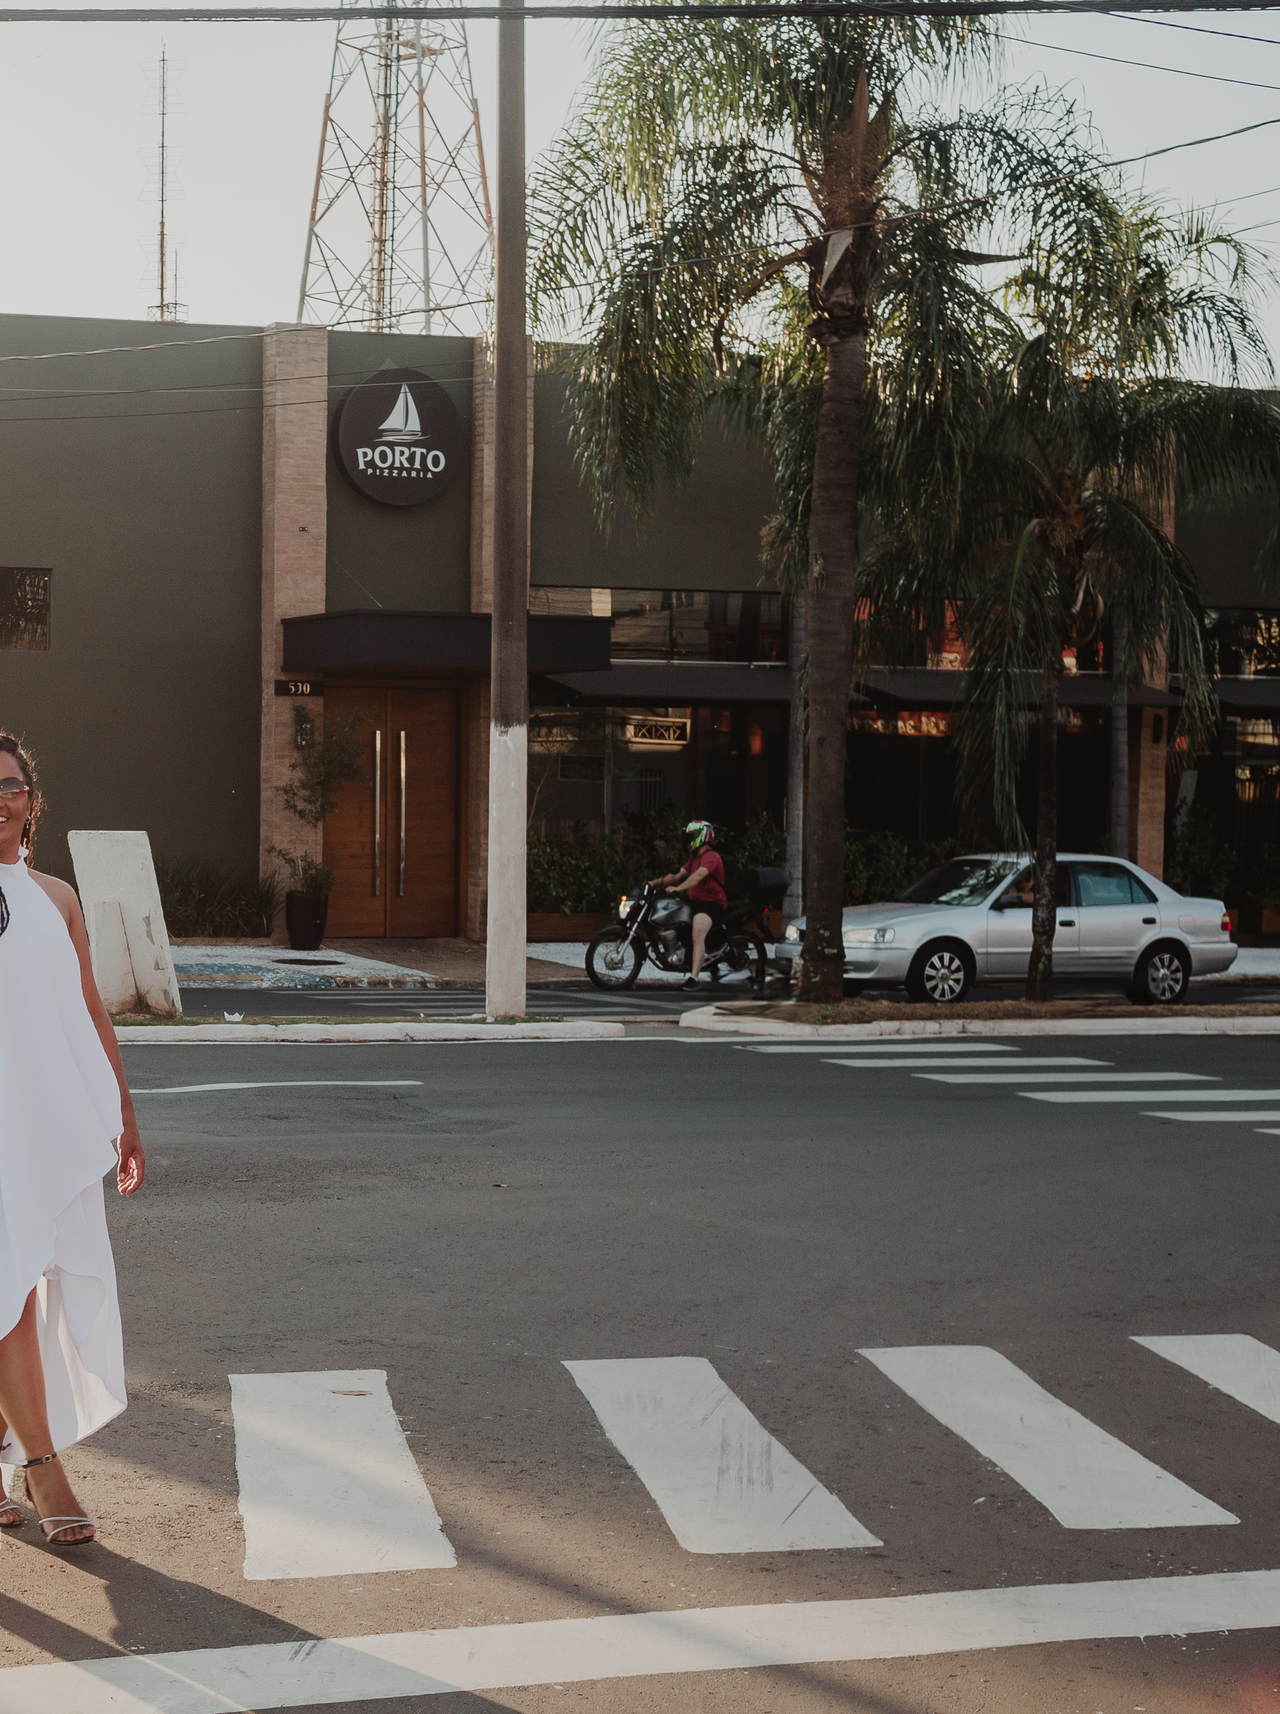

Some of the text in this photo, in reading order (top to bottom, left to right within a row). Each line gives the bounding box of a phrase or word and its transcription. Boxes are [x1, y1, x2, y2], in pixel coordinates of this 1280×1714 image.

[356, 446, 446, 472] PORTO
[367, 468, 433, 479] PIZZARIA
[288, 682, 311, 695] 530
